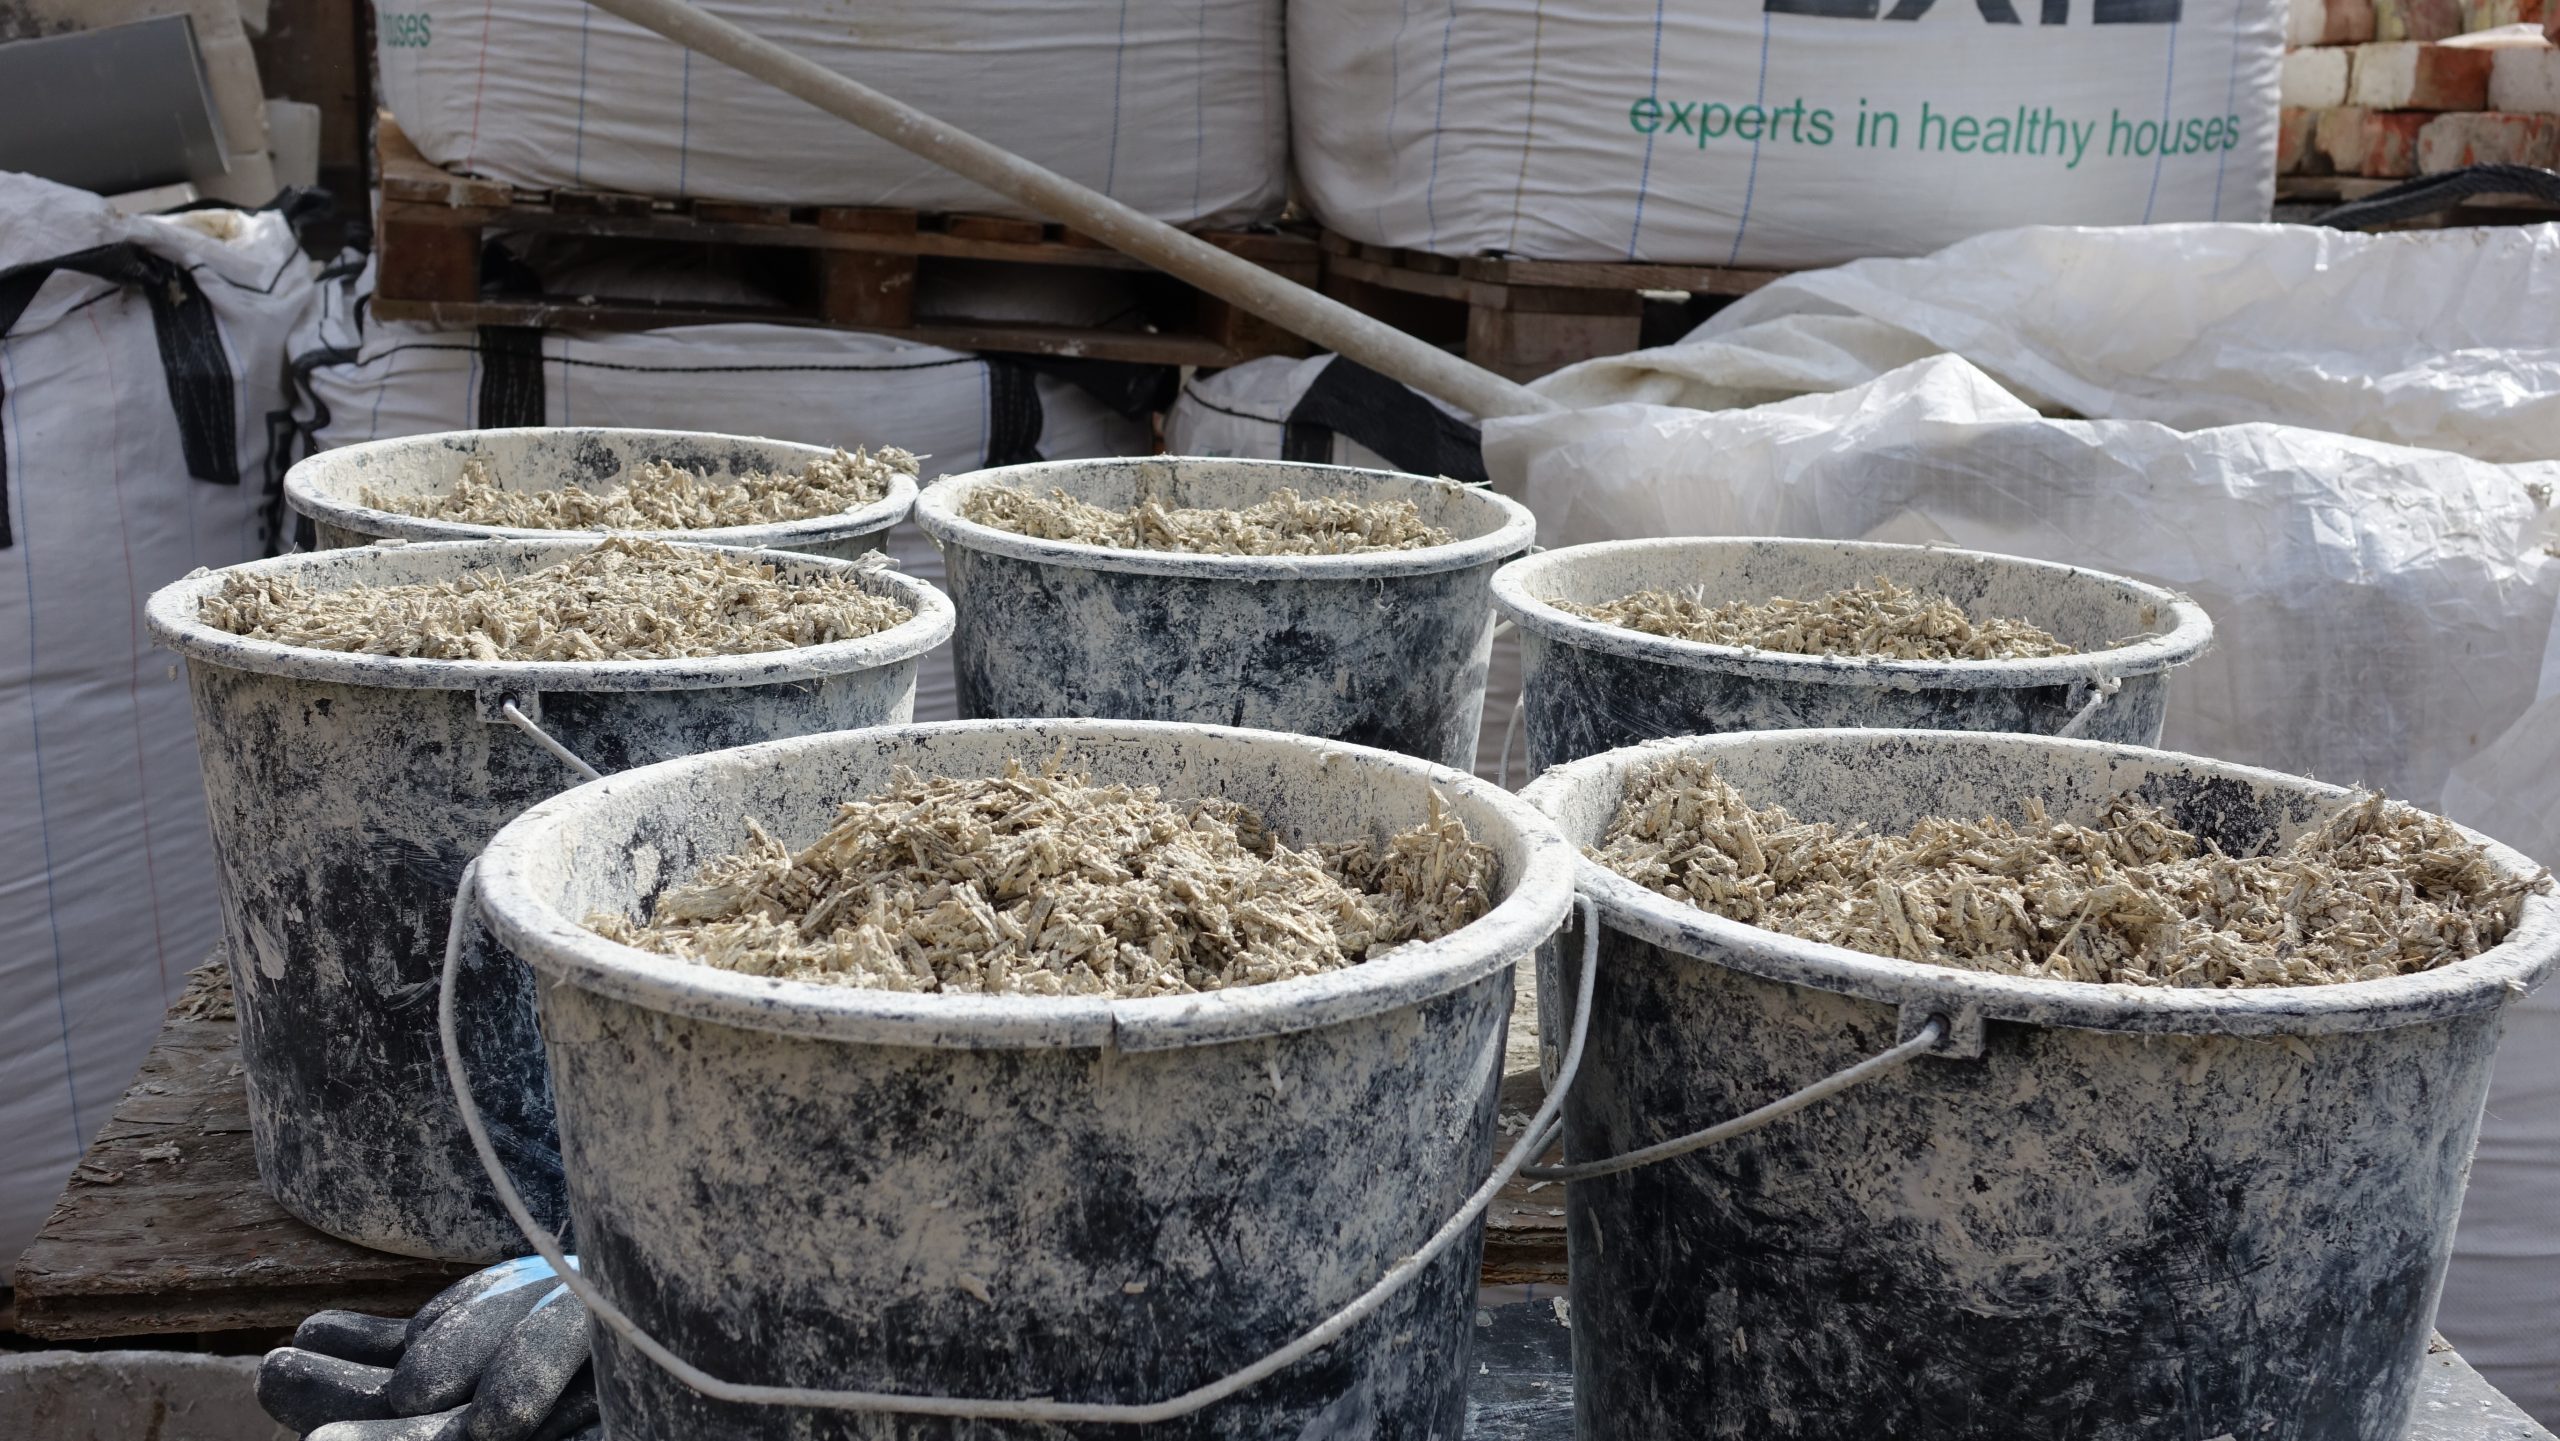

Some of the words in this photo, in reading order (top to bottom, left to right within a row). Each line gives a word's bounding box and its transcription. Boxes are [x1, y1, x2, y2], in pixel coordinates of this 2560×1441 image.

[1629, 97, 1835, 149] experts
[1856, 98, 1899, 148] in
[1918, 100, 2096, 169] healthy
[2106, 108, 2240, 156] houses
